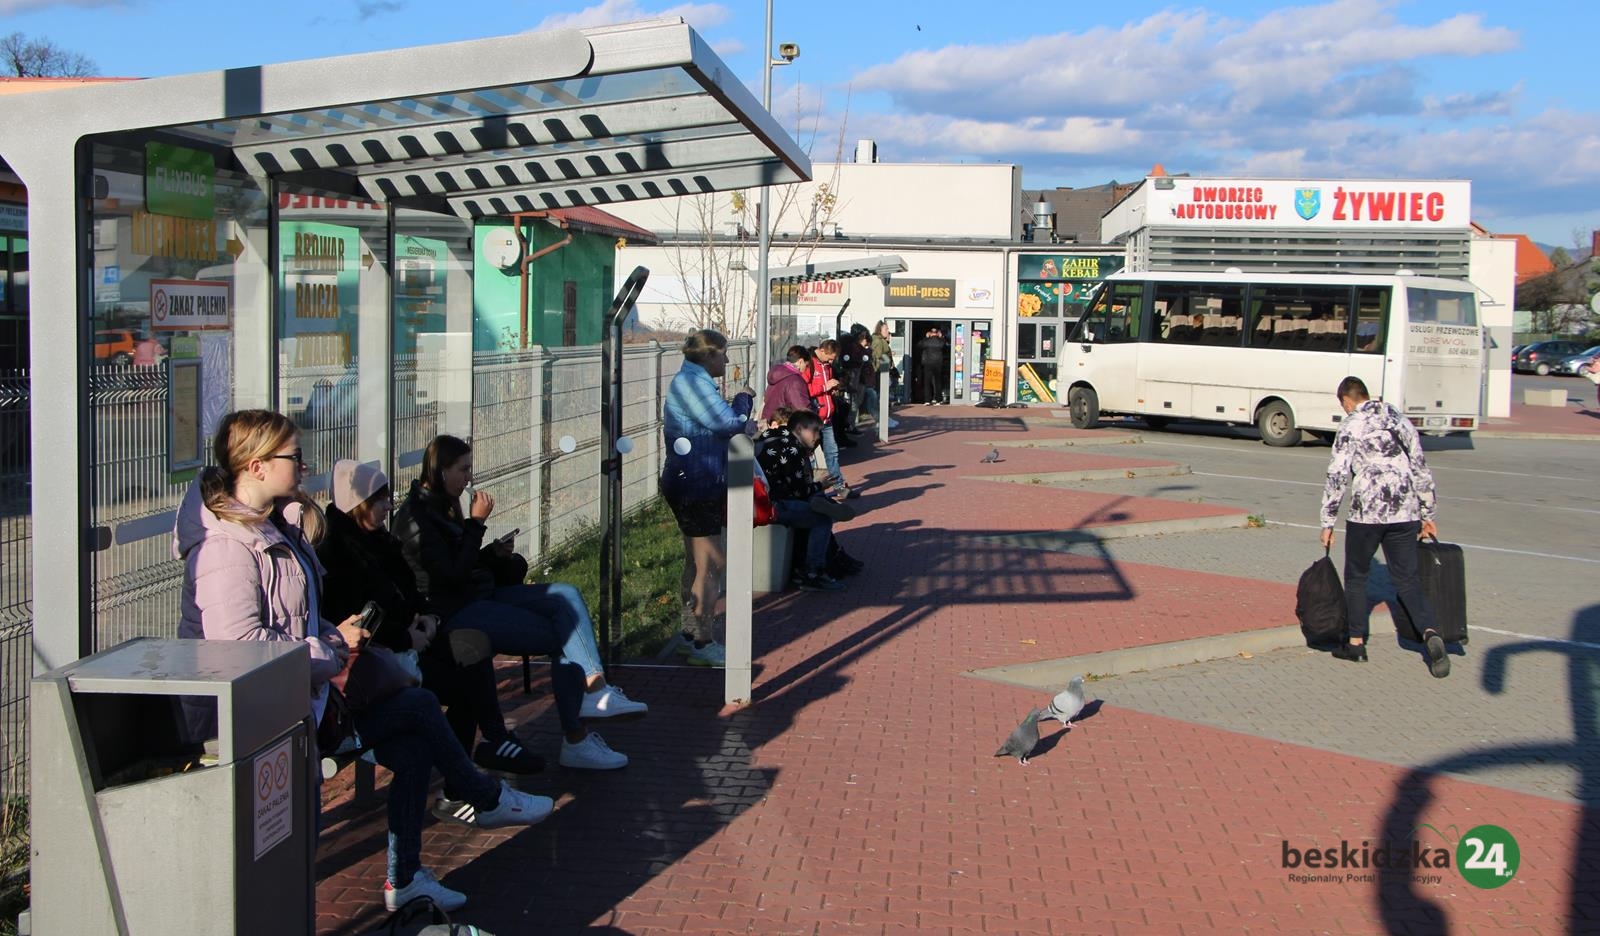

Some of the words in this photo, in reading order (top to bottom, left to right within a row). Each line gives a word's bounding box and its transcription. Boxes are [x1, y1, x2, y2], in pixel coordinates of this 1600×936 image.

[1193, 187, 1263, 203] DWORZEC
[1176, 203, 1277, 220] AUTOBUSOWY
[1332, 187, 1444, 222] ŻYWIEC
[294, 232, 345, 272] BROWAR
[1062, 258, 1099, 268] ZAHIR
[1062, 269, 1099, 278] KEBAB
[889, 285, 950, 298] multi-press
[169, 295, 194, 316] ZAKAZ
[197, 295, 227, 316] PALENIA
[295, 282, 339, 319] RAJCZA
